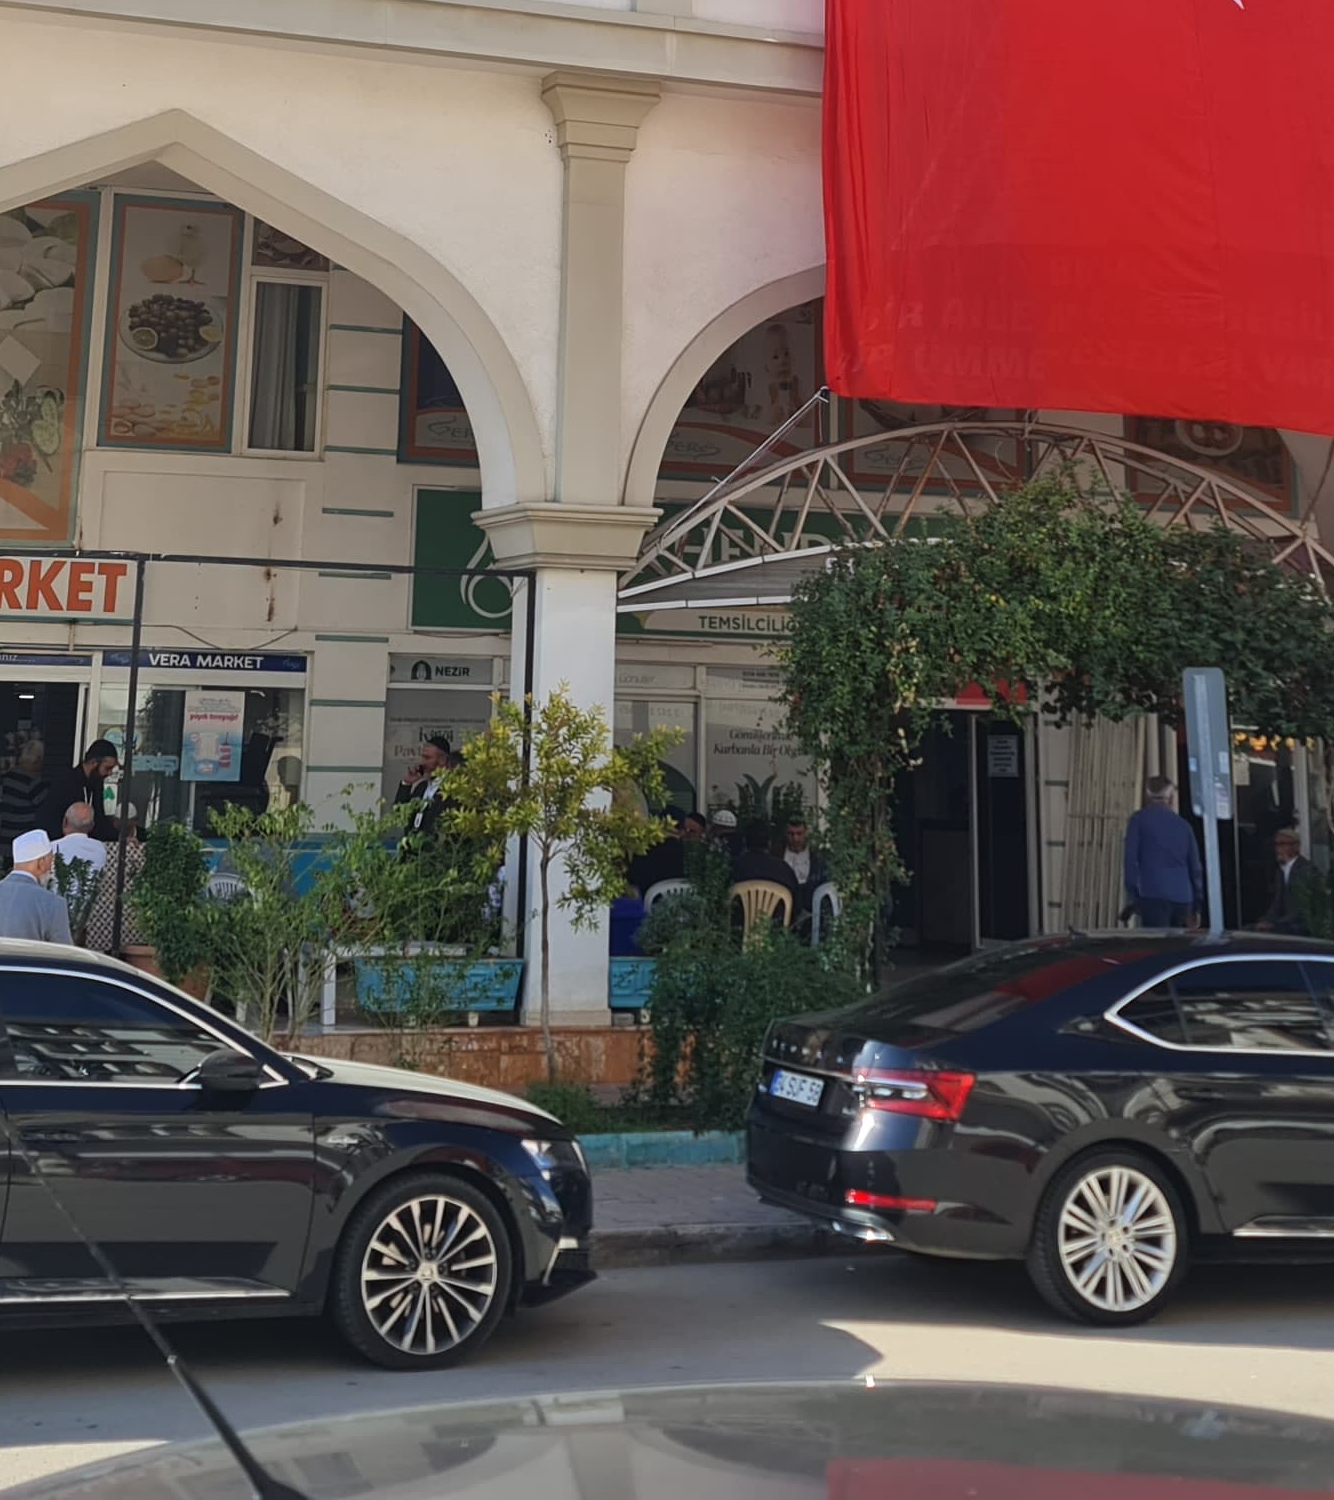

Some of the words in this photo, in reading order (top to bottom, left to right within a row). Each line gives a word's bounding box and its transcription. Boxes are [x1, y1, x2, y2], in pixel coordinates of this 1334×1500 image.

[698, 614, 797, 633] TEMSİLCİLİĞ
[148, 652, 192, 668] VERA
[196, 654, 265, 670] MARKET
